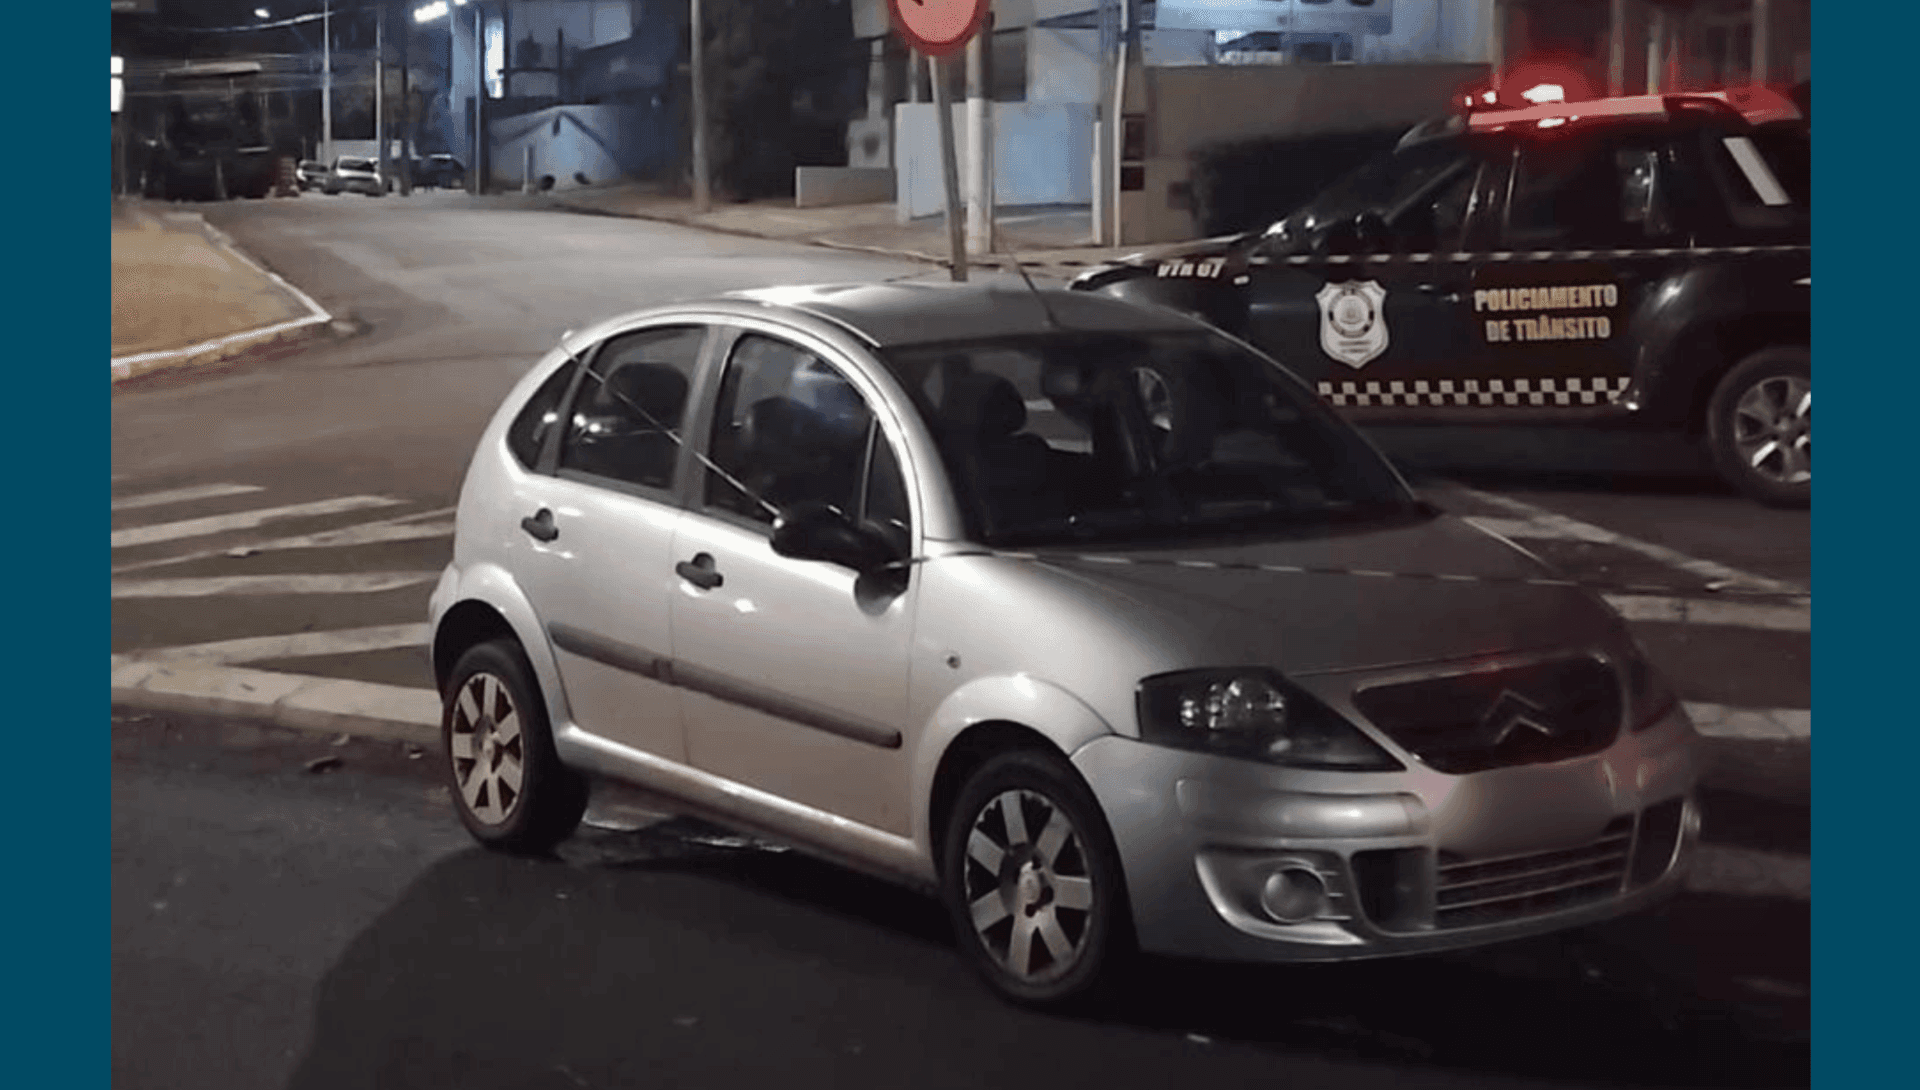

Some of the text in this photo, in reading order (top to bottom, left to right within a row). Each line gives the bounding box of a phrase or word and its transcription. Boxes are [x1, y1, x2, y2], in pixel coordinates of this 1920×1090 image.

[1474, 284, 1617, 312] POLICIAMENTO
[1486, 314, 1611, 342] DE TRÂNSITO
